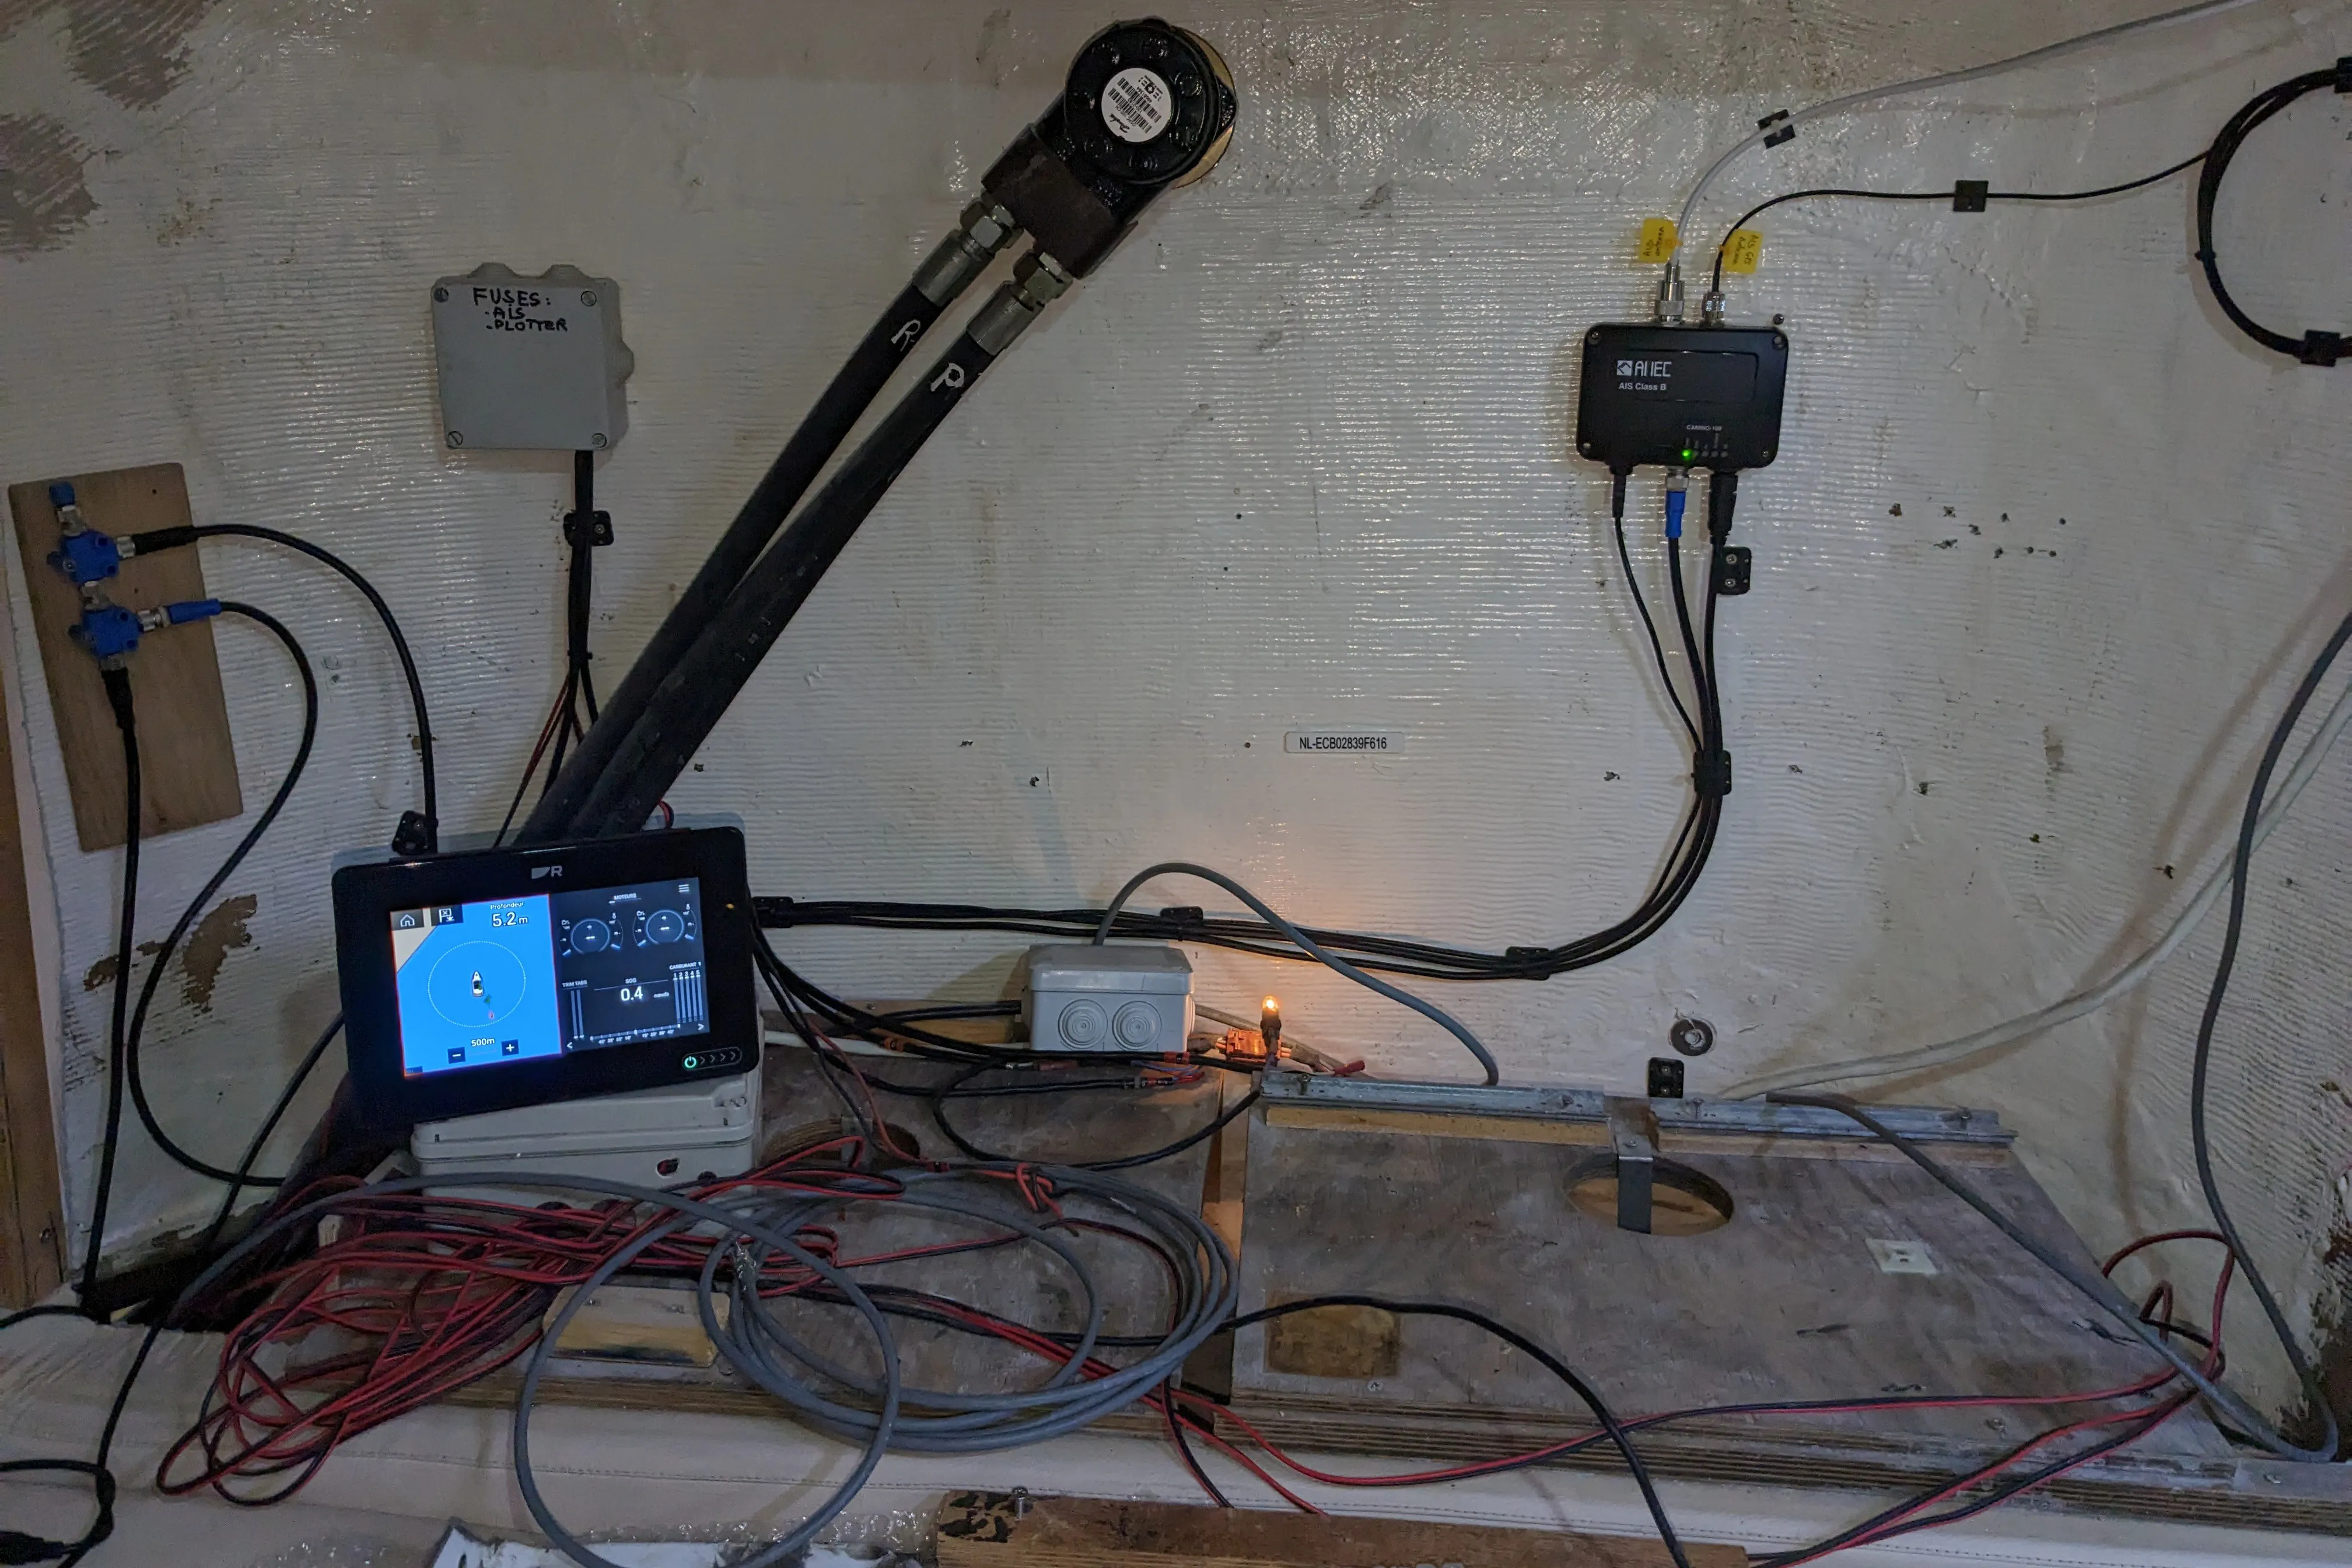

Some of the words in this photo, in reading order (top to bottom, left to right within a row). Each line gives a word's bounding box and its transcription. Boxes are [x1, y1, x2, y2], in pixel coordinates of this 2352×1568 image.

[930, 362, 965, 392] P
[1635, 382, 1658, 390] Class
[1300, 737, 1387, 749] NL-ECB02839F616
[491, 902, 524, 910] Profondeur
[492, 912, 516, 927] 5.2
[621, 986, 643, 1001] 0.4
[471, 1038, 495, 1047] 500m
